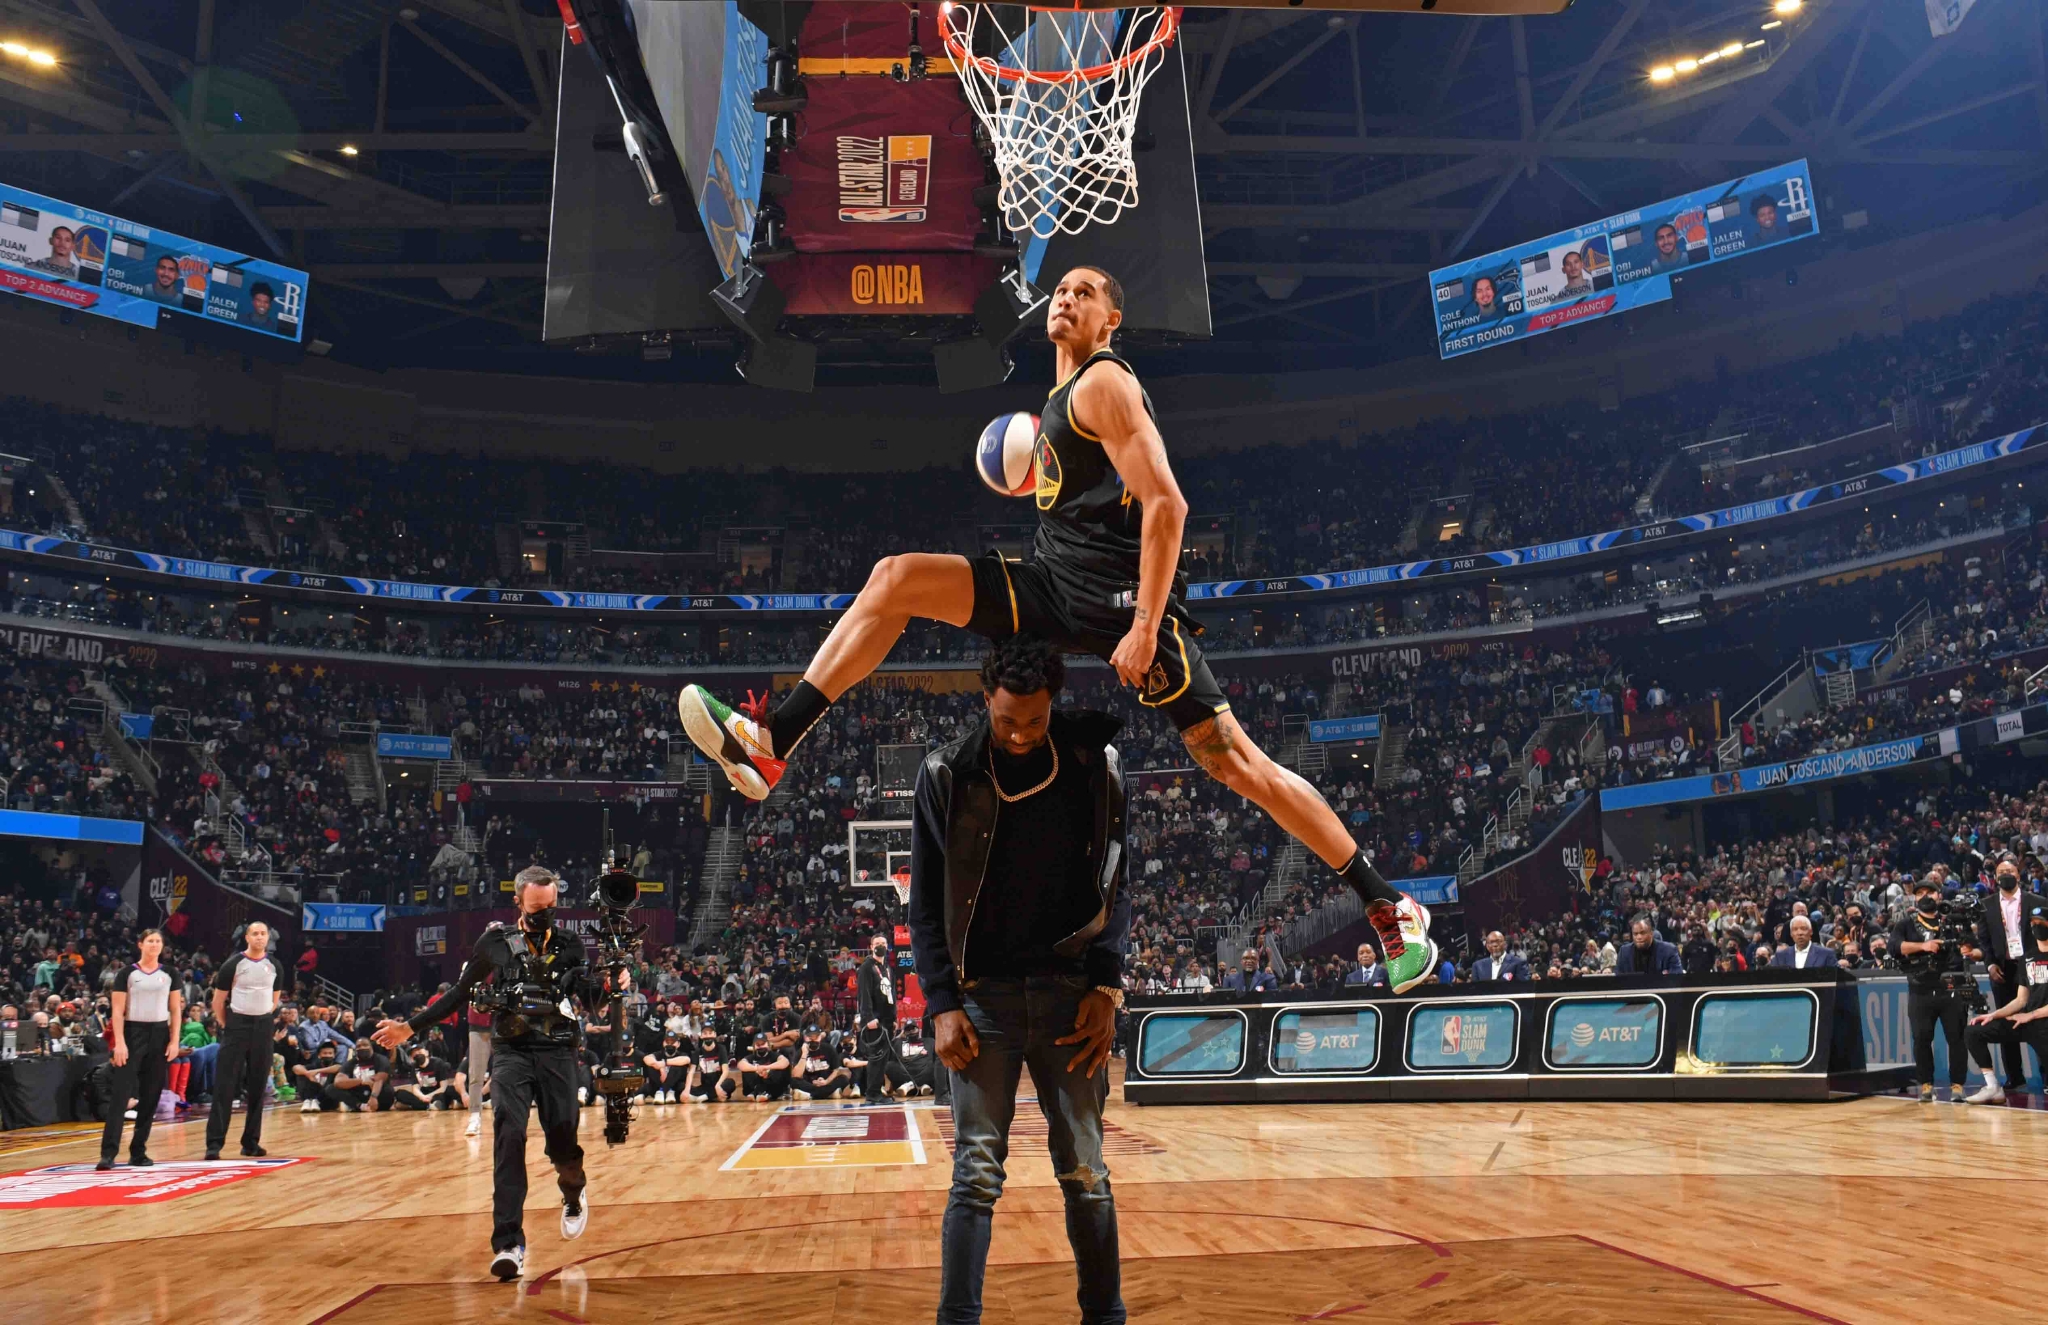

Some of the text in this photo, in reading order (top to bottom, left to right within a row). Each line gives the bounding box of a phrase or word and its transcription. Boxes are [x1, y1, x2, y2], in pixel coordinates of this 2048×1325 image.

[836, 136, 884, 161] 2022
[899, 169, 918, 201] CLEVELAND
[1791, 211, 1808, 219] TOTAL
[1583, 225, 1601, 235] AT&T
[1609, 216, 1625, 230] SLAM
[1712, 230, 1743, 246] JALEN
[1713, 240, 1746, 255] GREEN
[0, 252, 76, 277] OSCANO-ANDERSON
[1615, 262, 1632, 272] OBI
[108, 268, 125, 279] OBI
[1617, 267, 1652, 283] TOPPIN
[5, 274, 88, 303] TOP 2 ADVANCE
[106, 278, 144, 295] TOPPIN
[851, 264, 924, 304] @NBA
[1437, 289, 1450, 300] 40
[1525, 285, 1549, 299] JUAN
[1526, 283, 1592, 309] TOSCANO-ANDERSON
[208, 296, 238, 309] JALEN
[1507, 300, 1522, 313] 40
[206, 305, 238, 320] GREEN
[1440, 310, 1462, 323] COLE
[1539, 300, 1607, 325] TOP 2 ADVANCE
[1441, 315, 1481, 332] ANTHONY
[1445, 324, 1515, 352] FIRST ROUND
[1936, 445, 1986, 472] SLAM DUNK
[1844, 479, 1868, 494] AT&T
[1732, 502, 1778, 523] SLAM DUNK
[1644, 525, 1667, 538] AT&T
[91, 549, 117, 561] AT&T
[1538, 541, 1580, 560] SLAM DUNK
[185, 562, 232, 579] SLAM DUNK
[1453, 558, 1475, 570] AT&T
[302, 577, 327, 587] AT&T
[1349, 569, 1389, 585] SLAM DUNK
[391, 583, 434, 600] SLAM DUNK
[1187, 586, 1204, 598] UNK
[1266, 581, 1288, 591] AT&T
[501, 592, 523, 602] AT&T
[586, 594, 628, 609] SLAM DUNK
[692, 598, 713, 608] AT&T
[774, 595, 815, 609] SLAM DUNK
[558, 680, 581, 688] M126
[1324, 724, 1347, 735] AT&T
[1351, 722, 1364, 732] SLAM
[1998, 720, 2022, 733] TOTAL
[393, 741, 415, 750] AT&T
[1756, 742, 1917, 786] JUAN TOSCANO-ANDERSON
[650, 788, 665, 798] STAR
[665, 788, 678, 798] 2022
[1562, 847, 1597, 867] CLE 22
[150, 875, 188, 899] CLE 22
[1421, 888, 1440, 902] DUNK
[330, 916, 366, 929] SLAM DUNK
[897, 951, 913, 959] AT&
[898, 958, 914, 967] 5G
[1462, 1025, 1487, 1039] SLAM
[1598, 1026, 1642, 1042] AT&T
[1319, 1034, 1359, 1049] AT&T
[1461, 1038, 1486, 1051] DUNK
